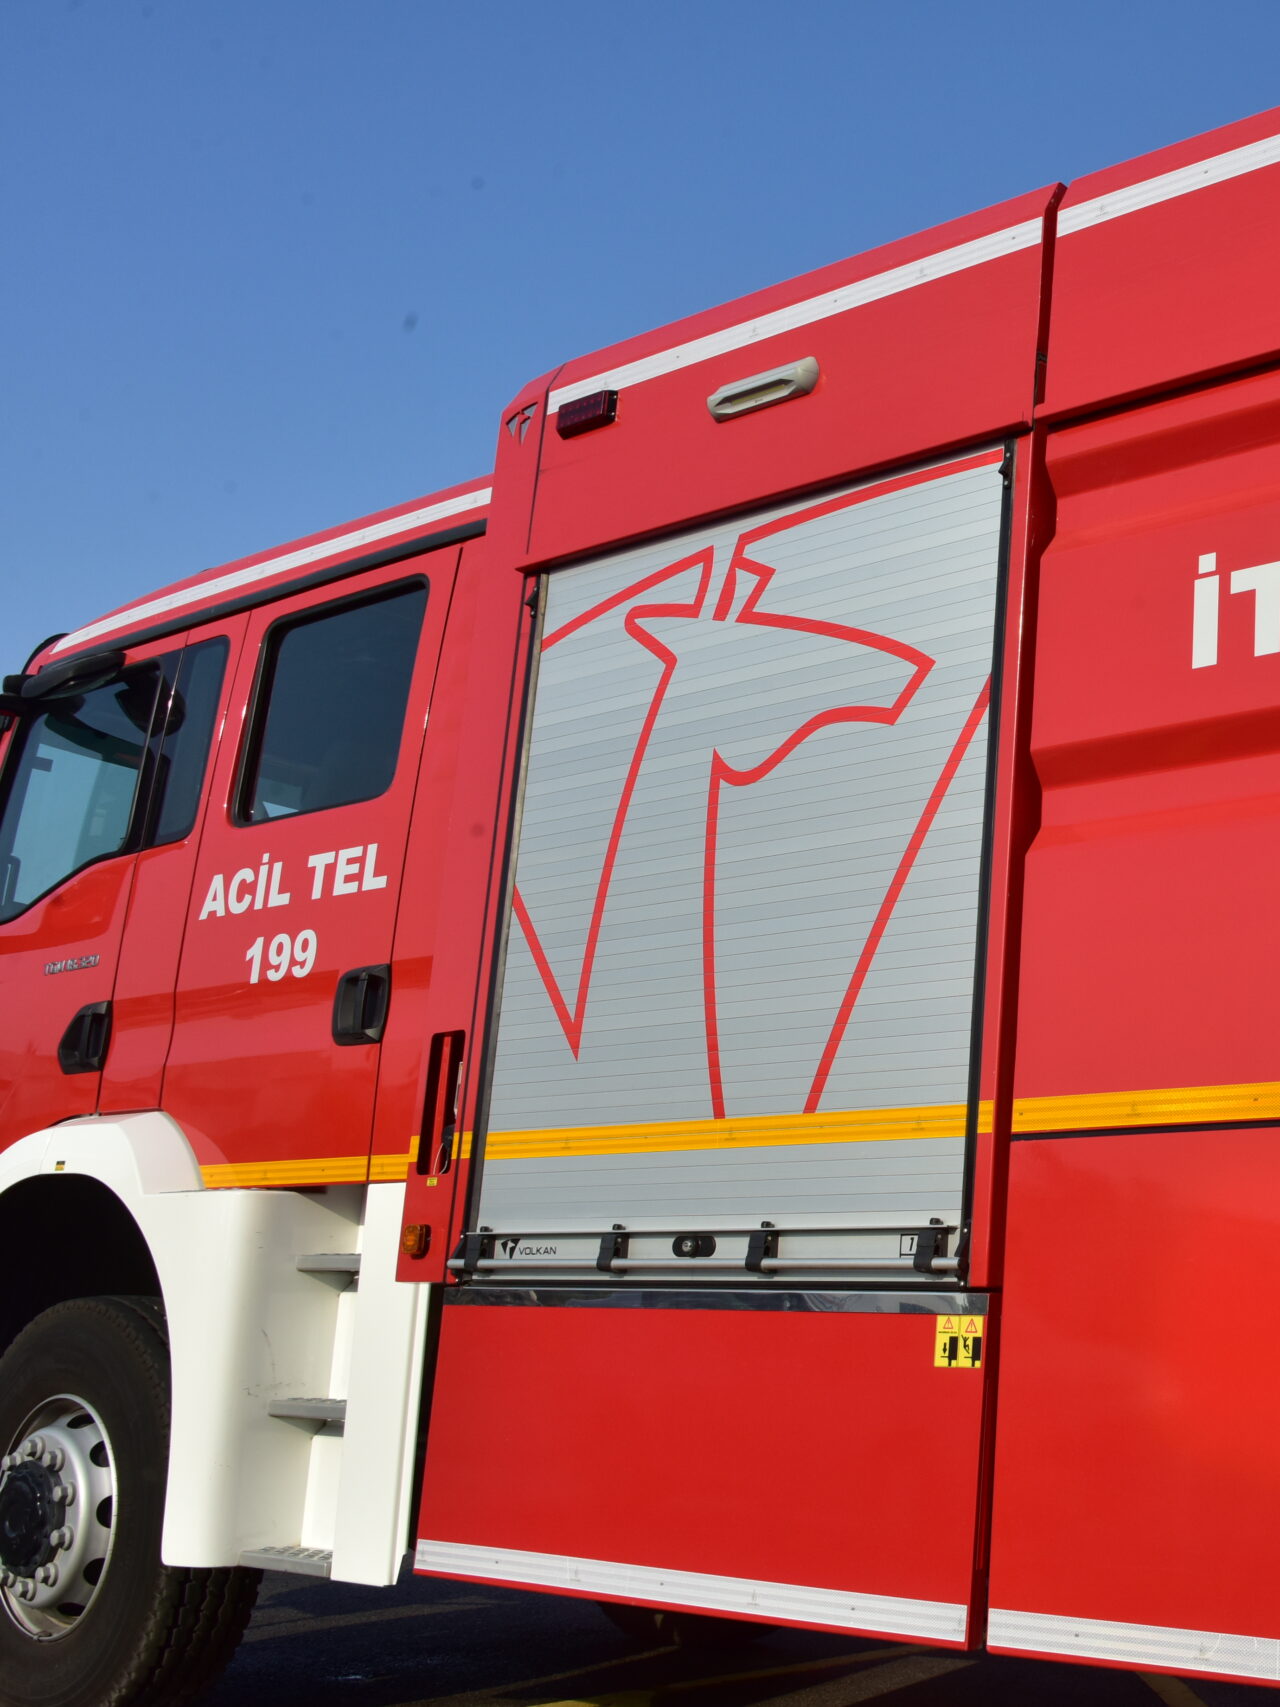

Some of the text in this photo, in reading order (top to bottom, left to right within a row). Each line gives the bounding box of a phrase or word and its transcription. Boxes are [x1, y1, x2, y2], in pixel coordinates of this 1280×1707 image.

[199, 843, 387, 920] ACİL TEL
[245, 929, 317, 984] 199
[519, 1246, 557, 1256] VOLKAN
